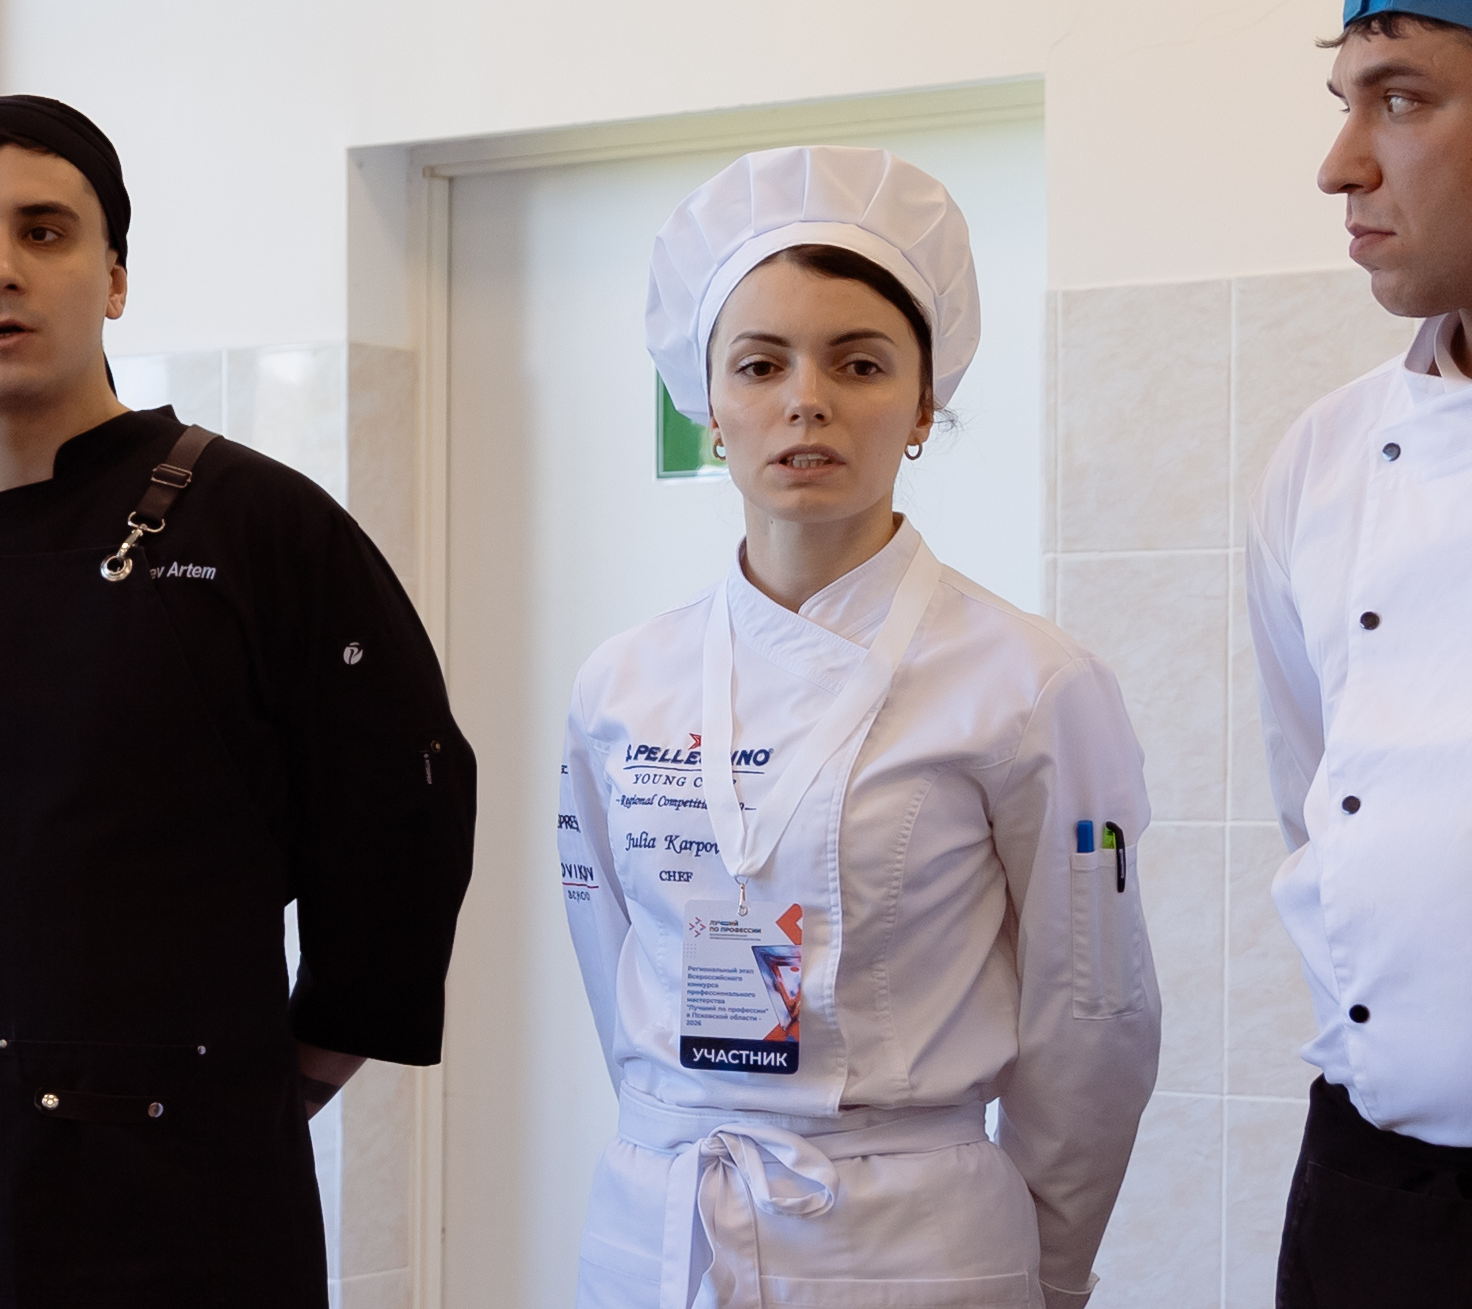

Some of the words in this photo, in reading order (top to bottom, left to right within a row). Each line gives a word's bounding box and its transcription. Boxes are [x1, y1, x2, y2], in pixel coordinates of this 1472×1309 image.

[166, 561, 217, 581] Artem
[633, 773, 687, 788] YOUNG
[625, 831, 656, 851] Julia
[658, 870, 694, 883] CHEF
[692, 1047, 788, 1067] УЧАСТНИК
